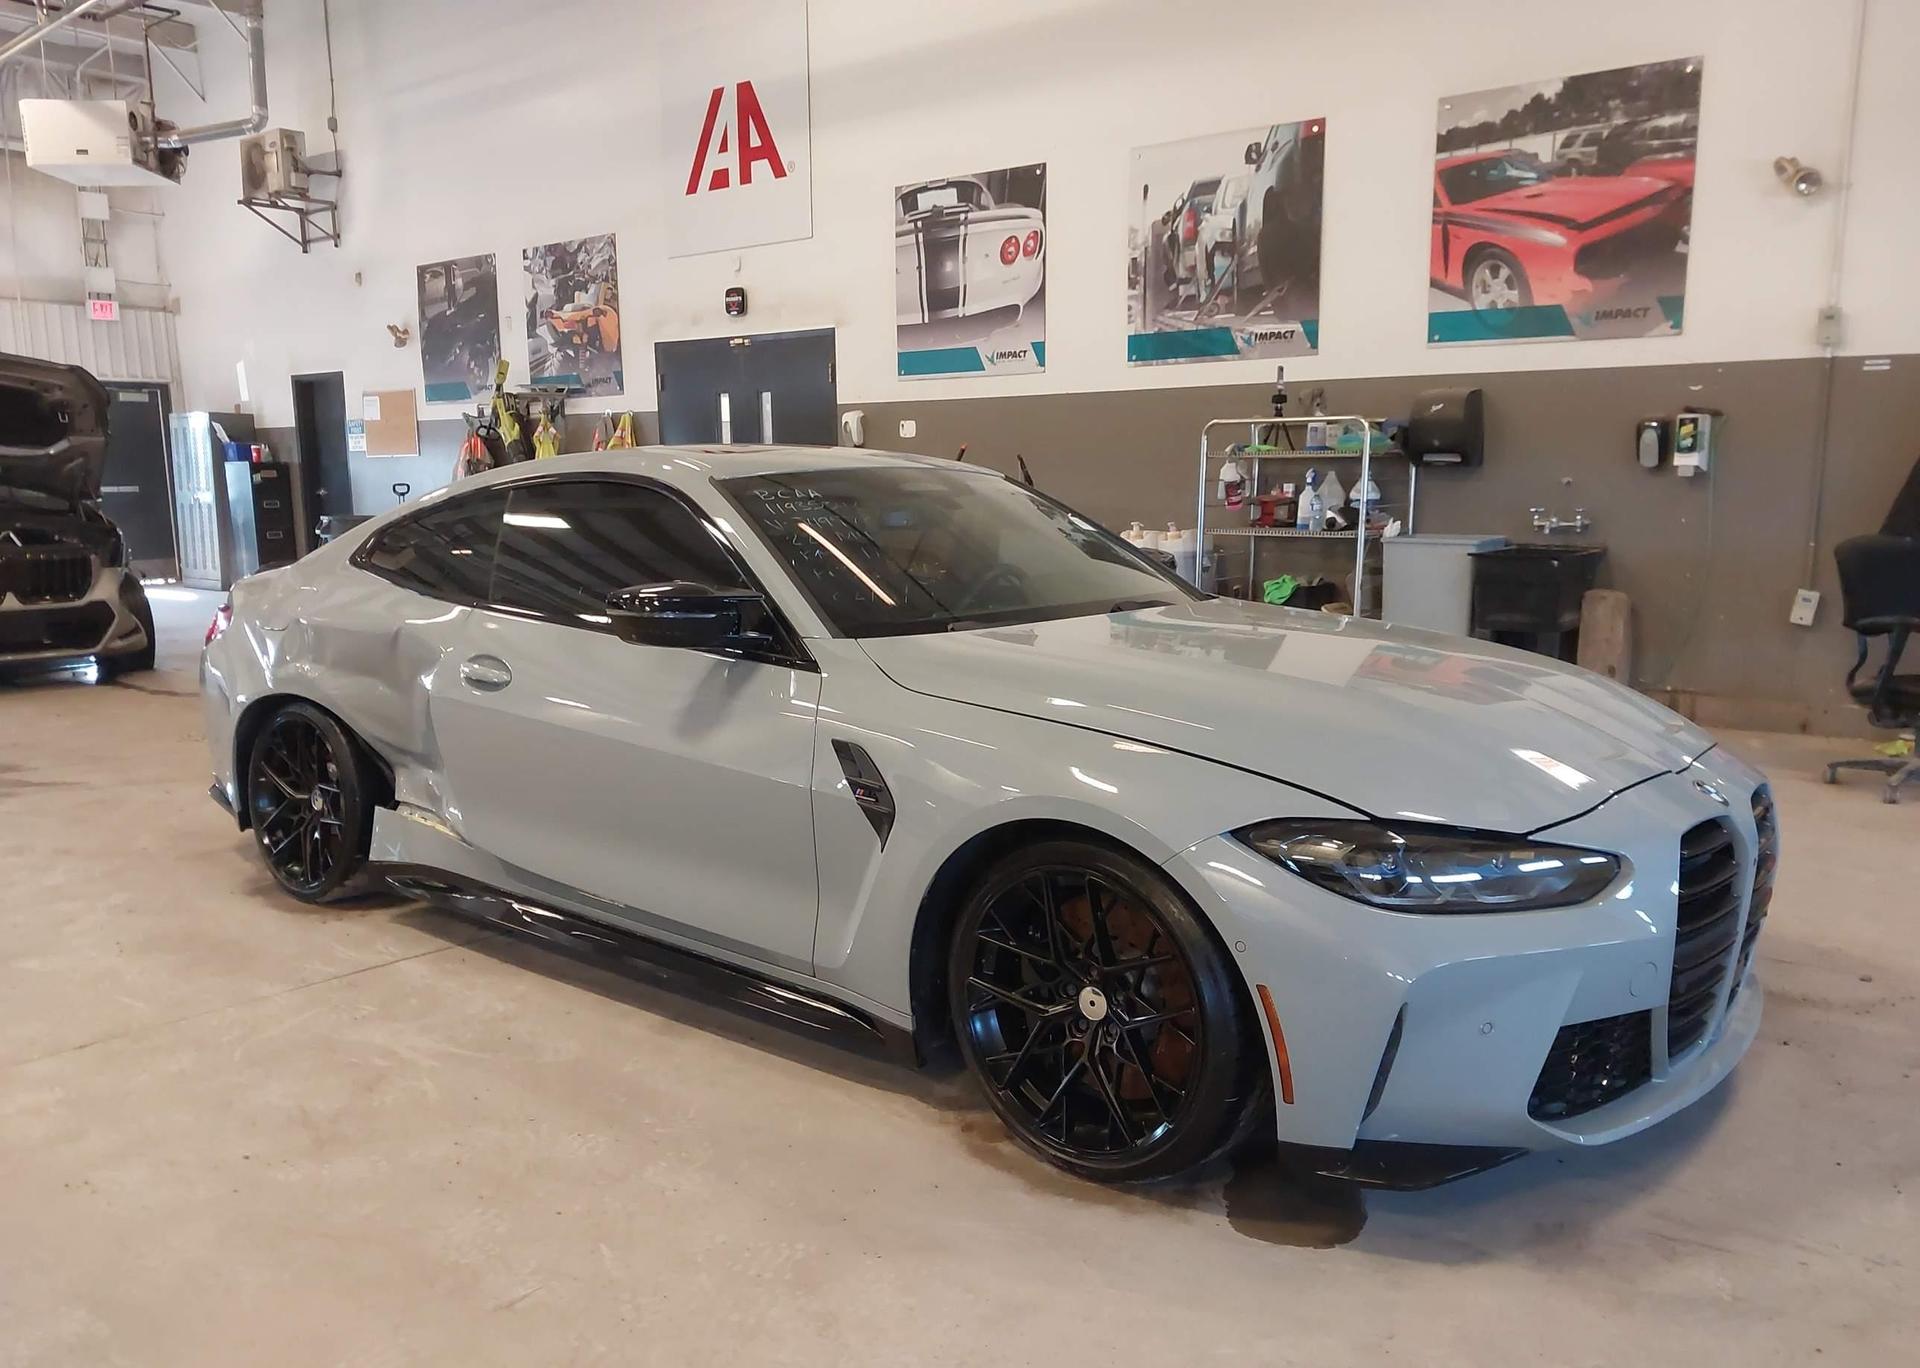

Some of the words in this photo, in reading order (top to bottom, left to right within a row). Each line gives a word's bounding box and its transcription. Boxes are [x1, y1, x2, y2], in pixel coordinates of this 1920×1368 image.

[1594, 307, 1650, 320] IMPACT
[1254, 330, 1295, 341] IMPACT
[996, 350, 1027, 359] IMPACT
